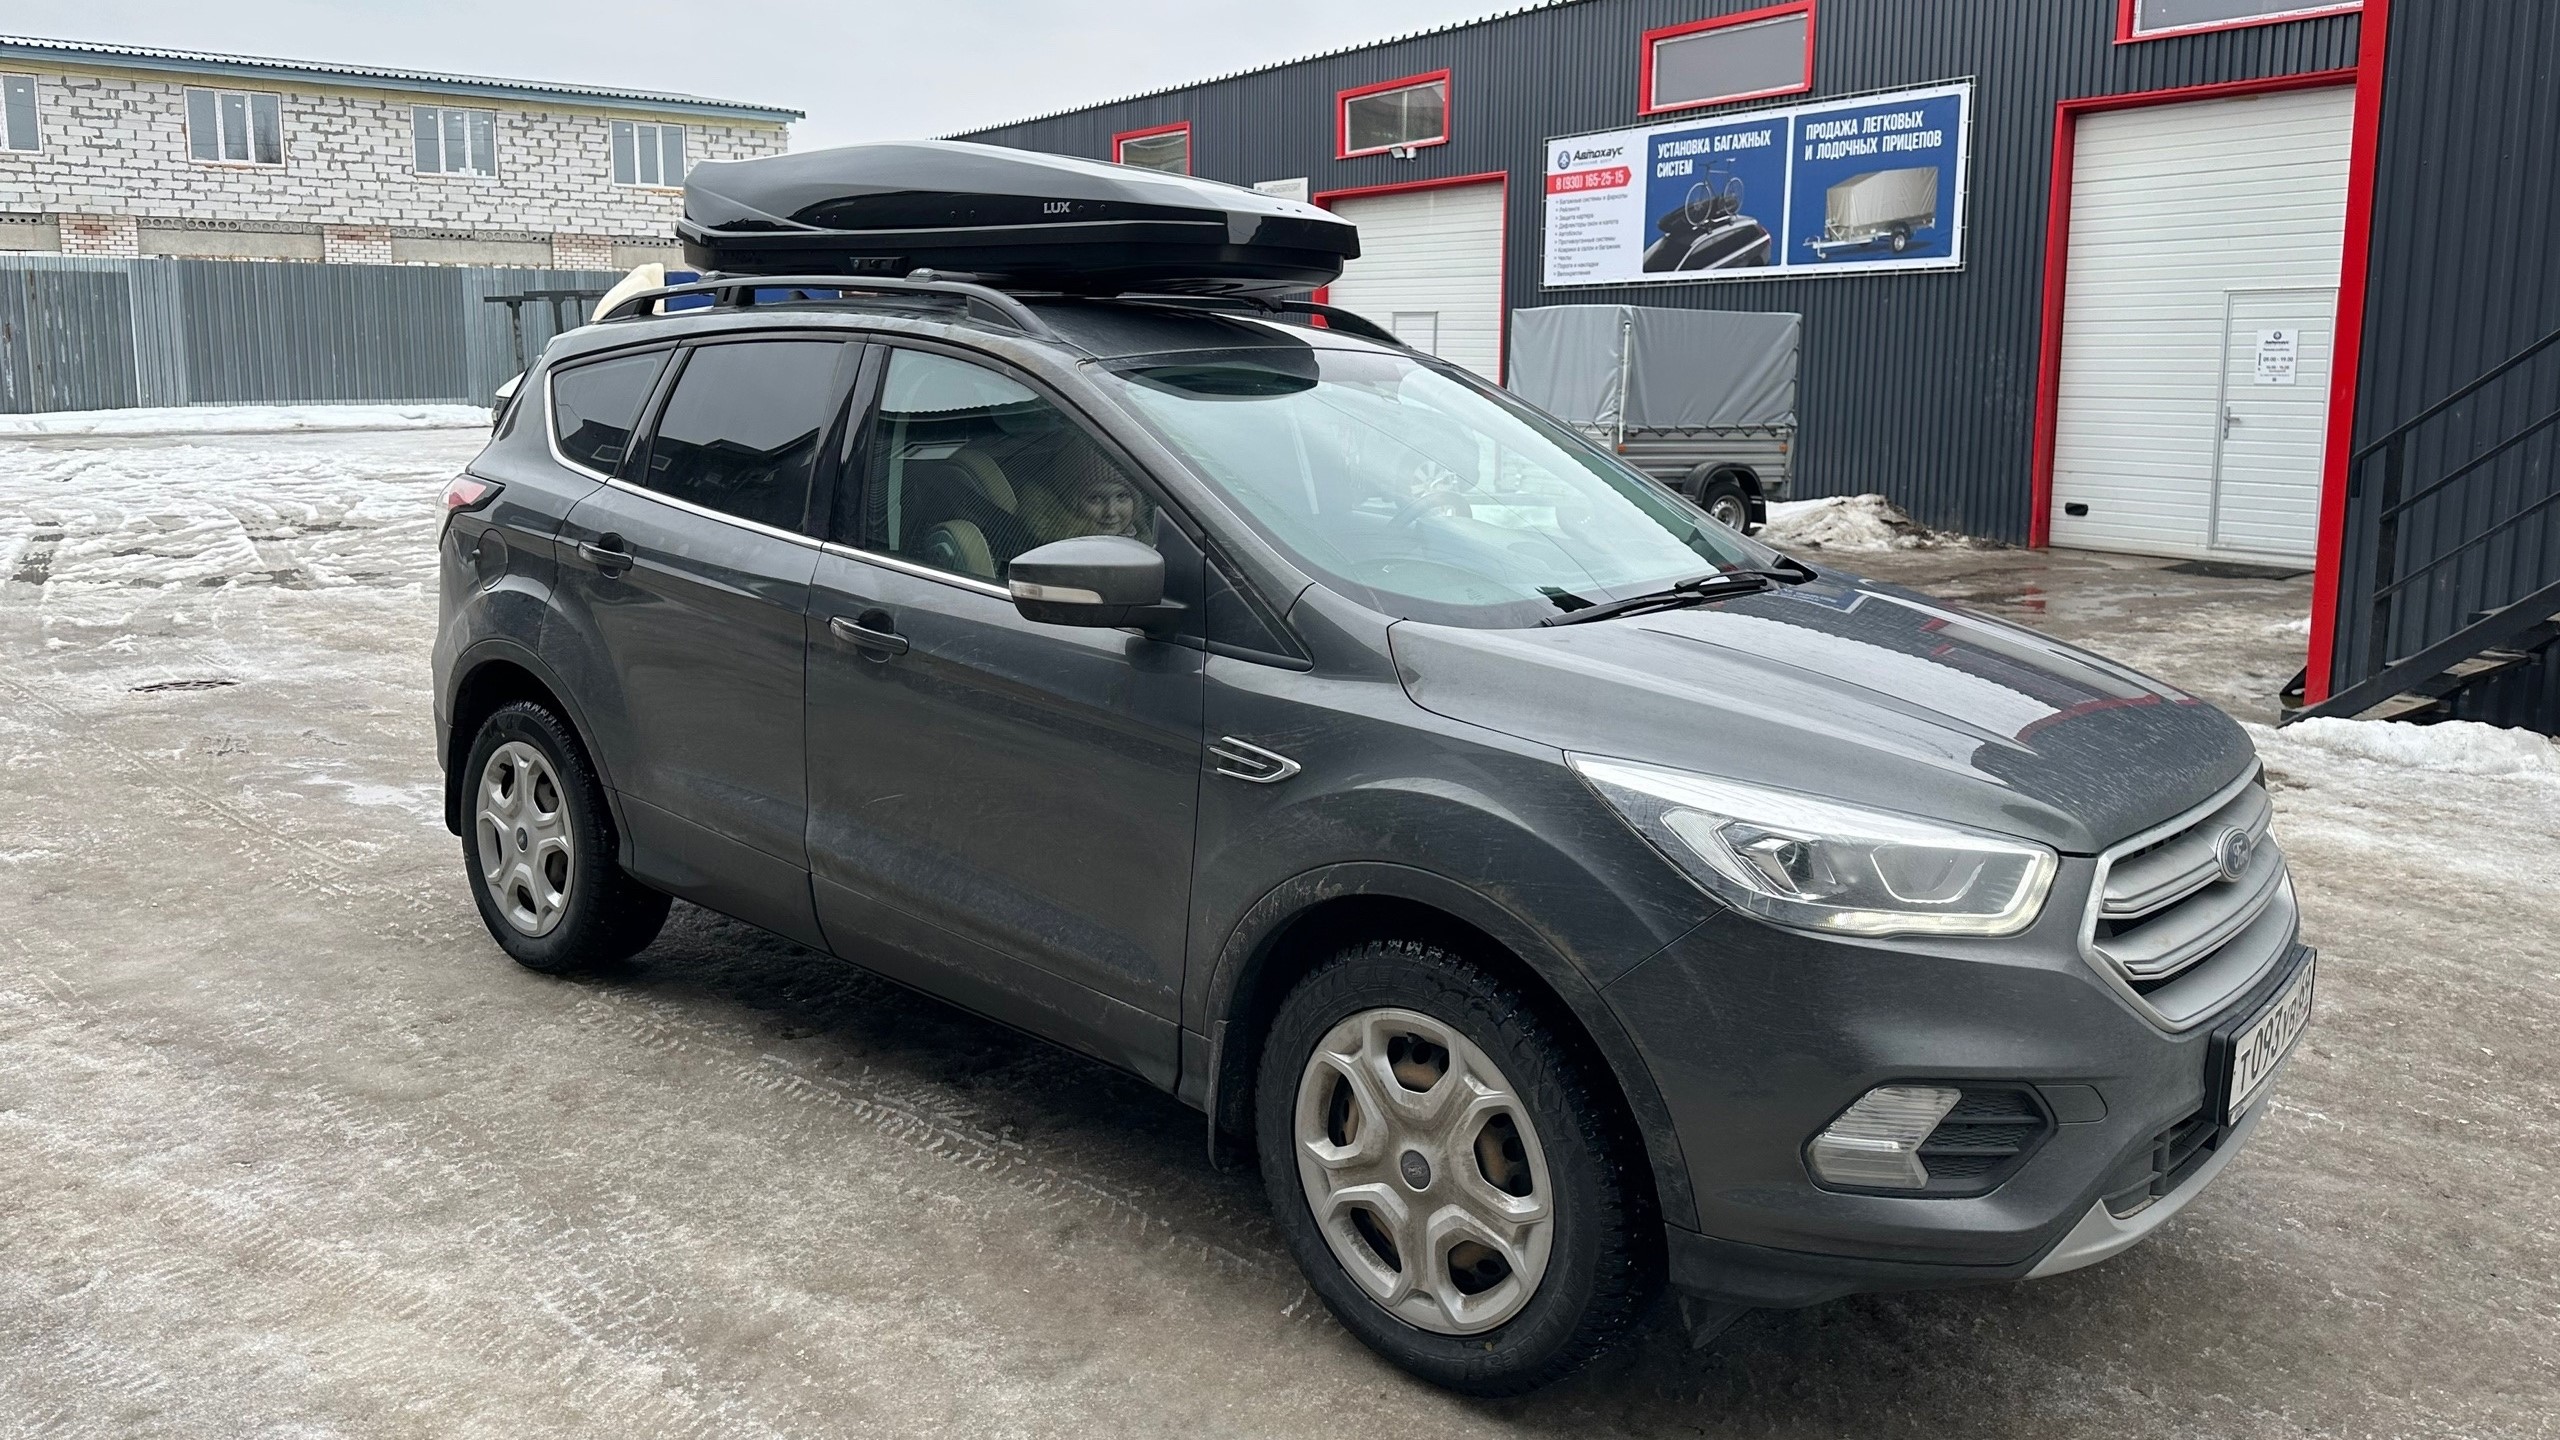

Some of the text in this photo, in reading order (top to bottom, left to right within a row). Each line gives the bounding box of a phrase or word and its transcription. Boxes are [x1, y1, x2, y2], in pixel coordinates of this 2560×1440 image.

[1806, 110, 1924, 140] ПРОДАЖА ЛЕГКОВЫХ
[1573, 146, 1624, 161] Автохаус
[1657, 130, 1772, 159] УСТАНОВКА БАГАЖНЫХ
[1805, 130, 1942, 160] И ЛОДОЧНЫХ ПРИЦЕПОВ
[1656, 159, 1693, 178] СИСТЕМ
[1555, 170, 1625, 191] 8 (930) 165-25-15
[1043, 201, 1071, 214] LUX
